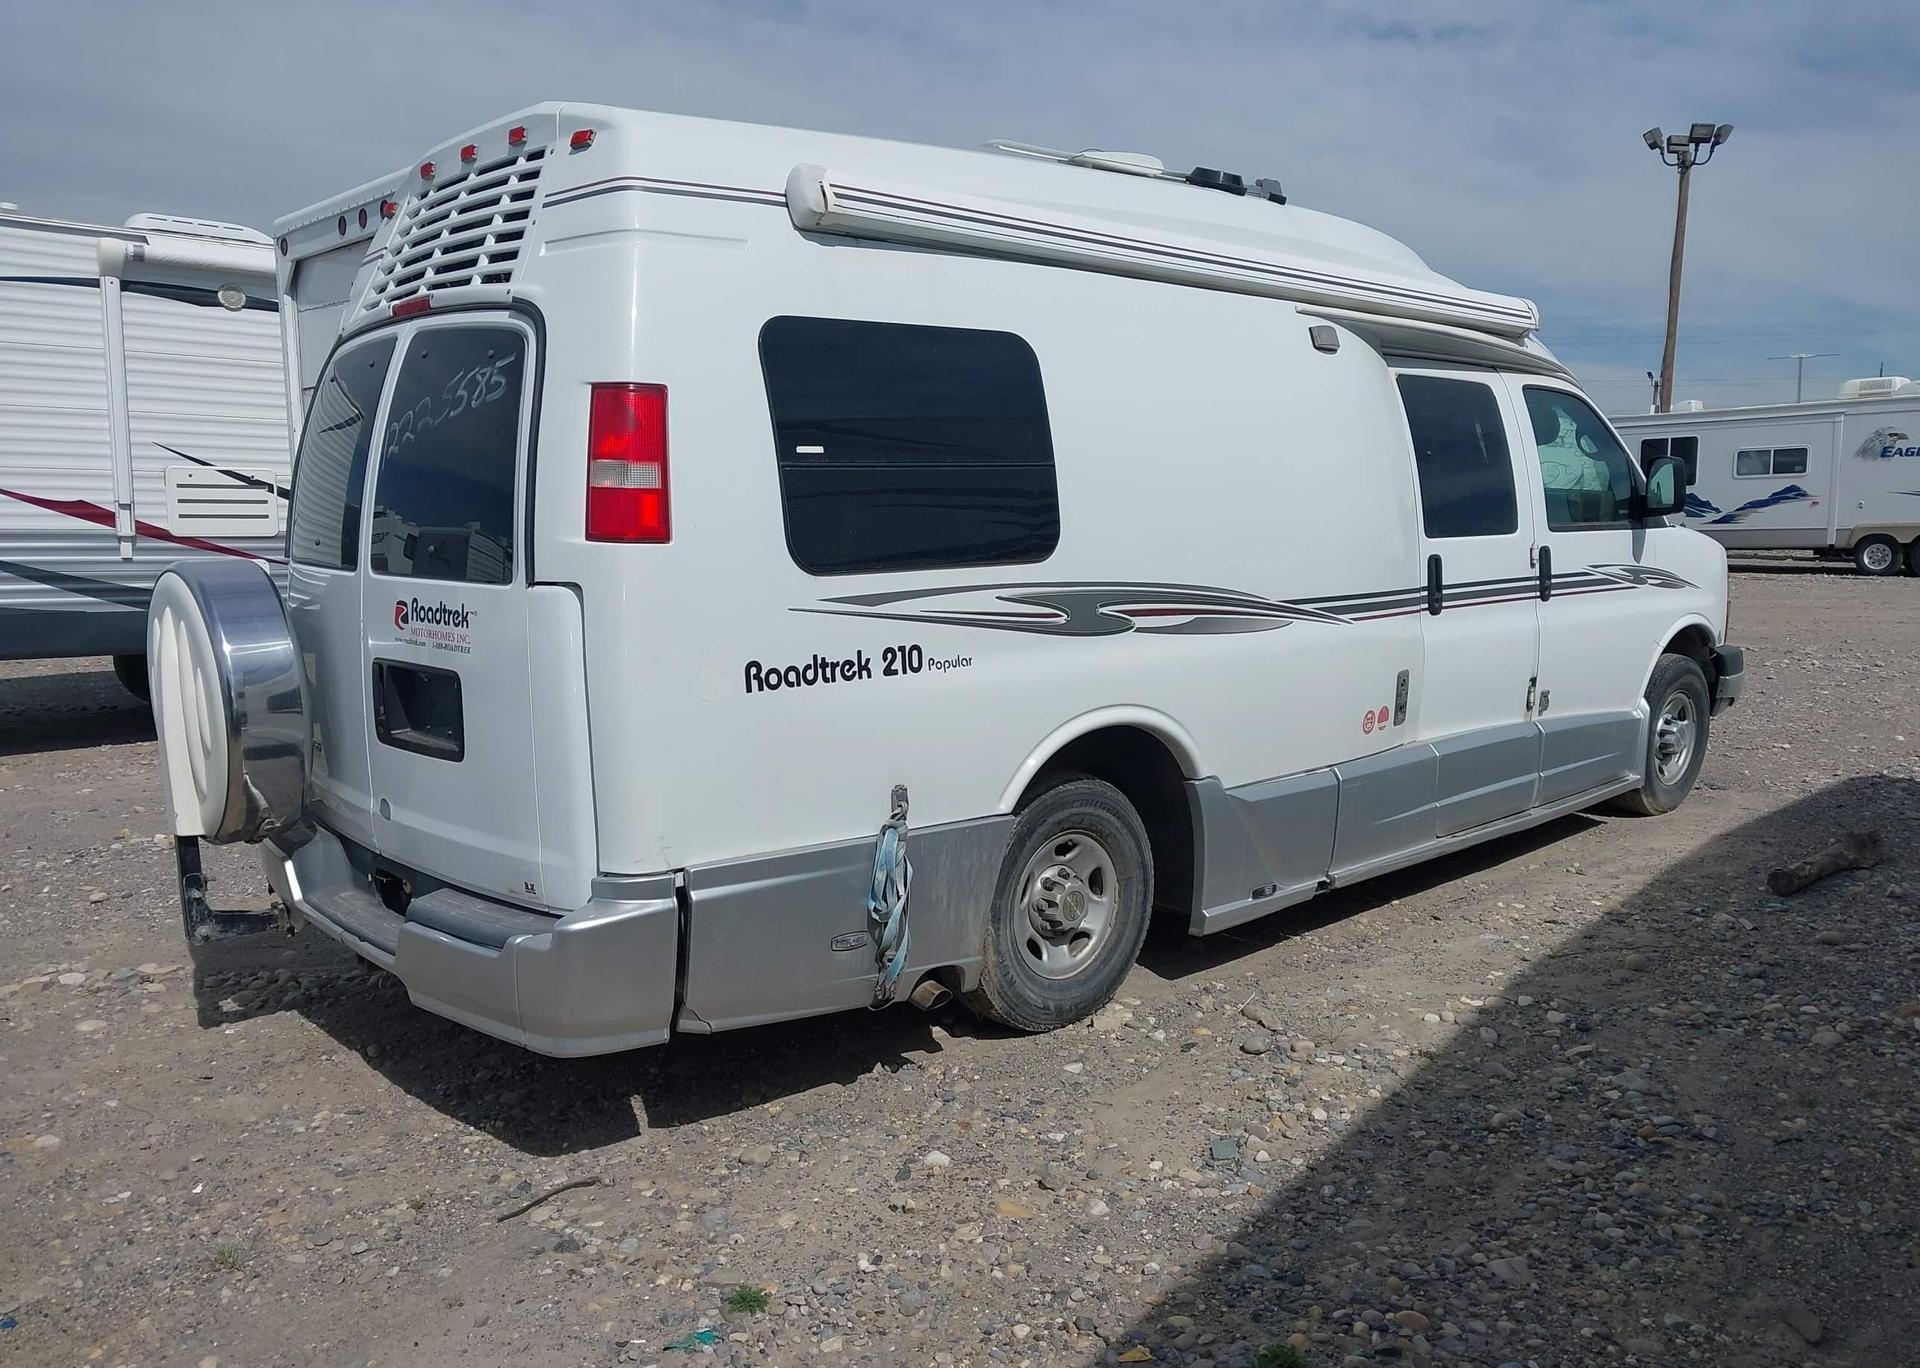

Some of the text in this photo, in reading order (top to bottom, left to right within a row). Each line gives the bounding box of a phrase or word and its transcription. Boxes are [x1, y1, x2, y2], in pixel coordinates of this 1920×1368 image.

[411, 597, 469, 629] Roadtrek
[411, 627, 454, 643] MOTORHOMES
[745, 644, 973, 693] Roadtrek 210 Popular
